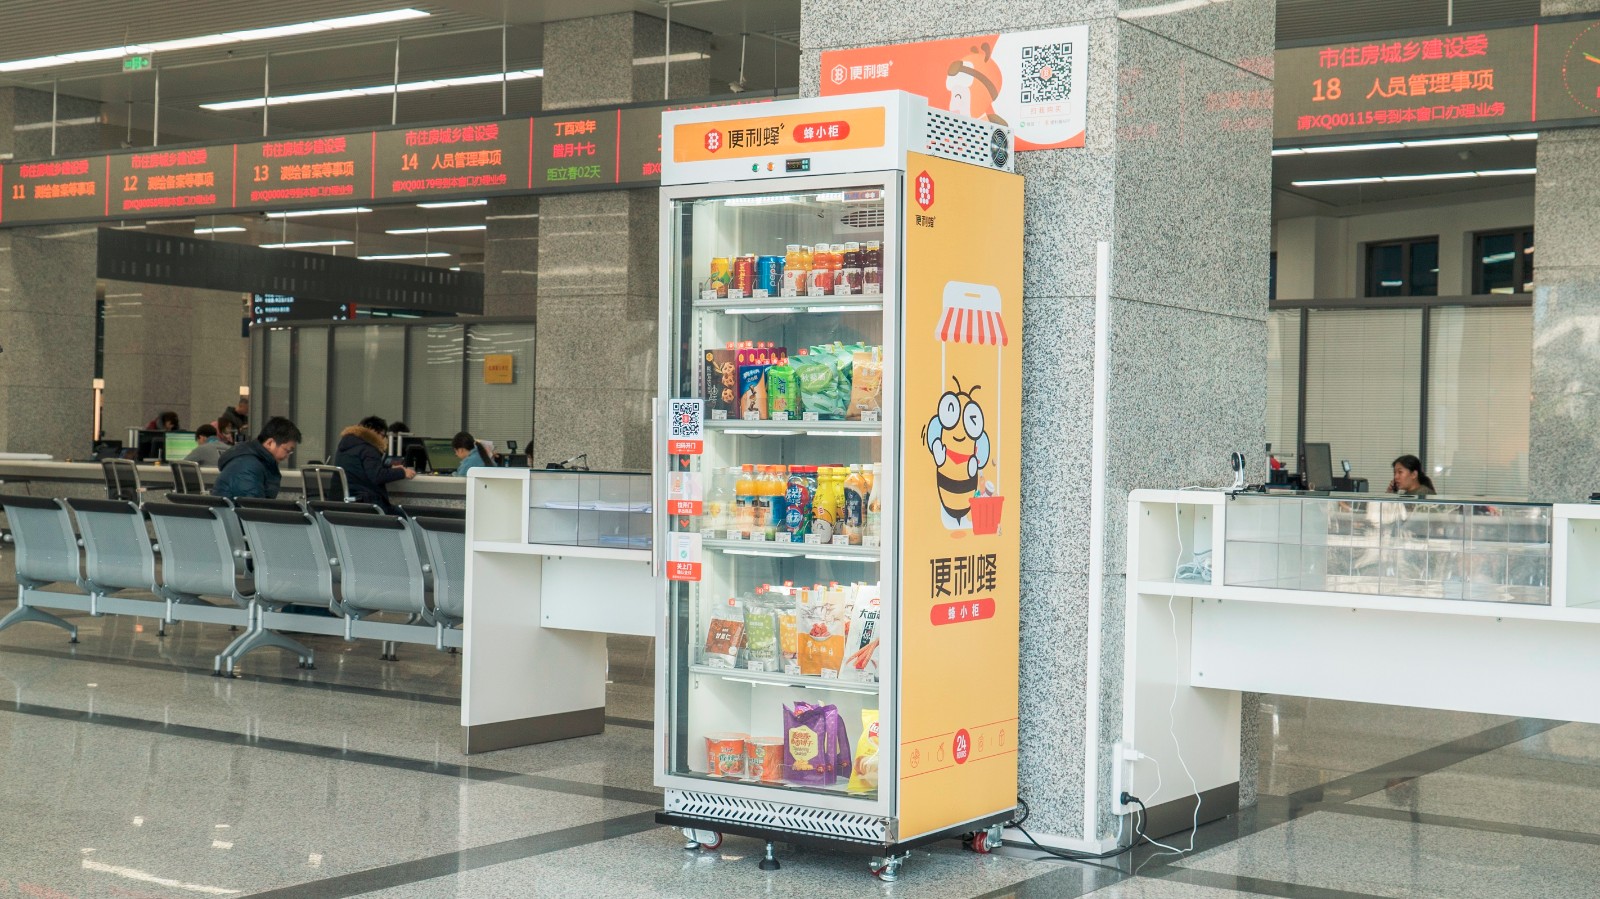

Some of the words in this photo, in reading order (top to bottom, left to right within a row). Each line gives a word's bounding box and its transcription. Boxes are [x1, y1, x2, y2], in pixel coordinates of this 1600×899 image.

[1318, 33, 1488, 70] 市住房城乡建设委
[849, 63, 889, 81] 便利蜂
[1312, 77, 1342, 102] 18
[1366, 68, 1494, 99] 人员管理事项
[405, 124, 499, 147] 市住房城乡建设委
[554, 120, 597, 137] 丁酉鸡年
[728, 126, 780, 149] 便利蜂
[803, 125, 839, 139] 蜂小柜
[262, 137, 347, 159] 市住房城乡建设委
[553, 141, 596, 159] 腊月十七
[402, 153, 419, 171] 14
[432, 149, 502, 170] 人员管理事项
[253, 164, 270, 183] 13
[547, 165, 600, 182] 距立春02天
[12, 184, 26, 200] 11
[123, 175, 139, 192] 12
[915, 214, 935, 228] 便利蜂
[930, 553, 997, 599] 便利蜂
[947, 603, 980, 621] 蜂小柜
[956, 735, 967, 752] 24
[956, 750, 967, 760] HOURS
